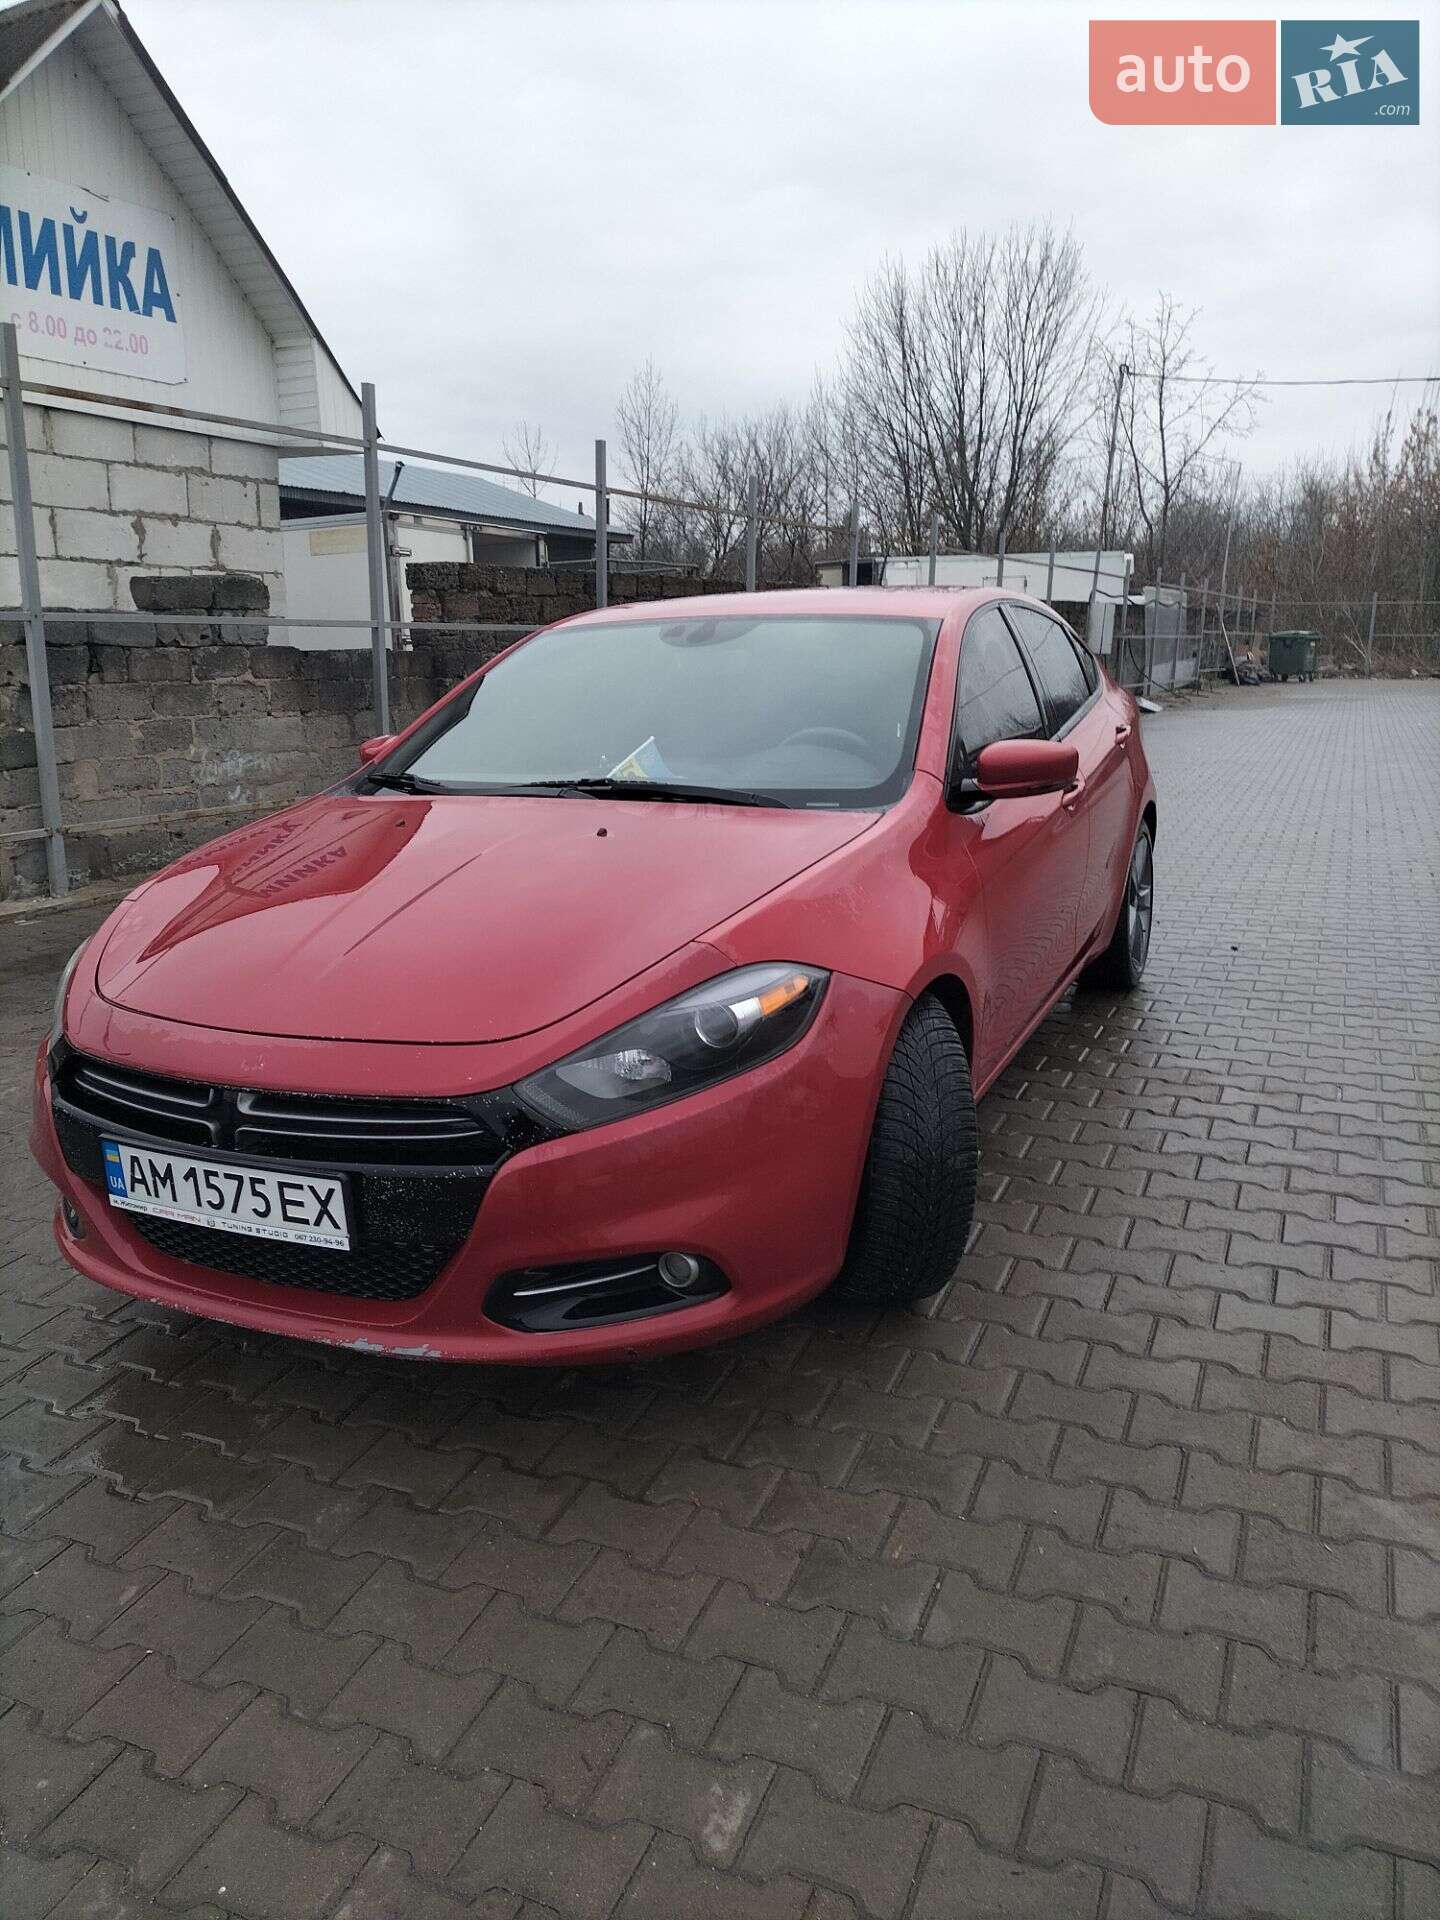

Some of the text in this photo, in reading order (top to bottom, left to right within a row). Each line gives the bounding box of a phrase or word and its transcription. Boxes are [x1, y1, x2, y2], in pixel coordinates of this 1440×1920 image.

[28, 310, 67, 339] 8.00
[74, 327, 97, 347] до
[103, 326, 149, 355] 22.00
[110, 1175, 125, 1191] UA
[221, 1221, 289, 1239] TUNING STUDIO
